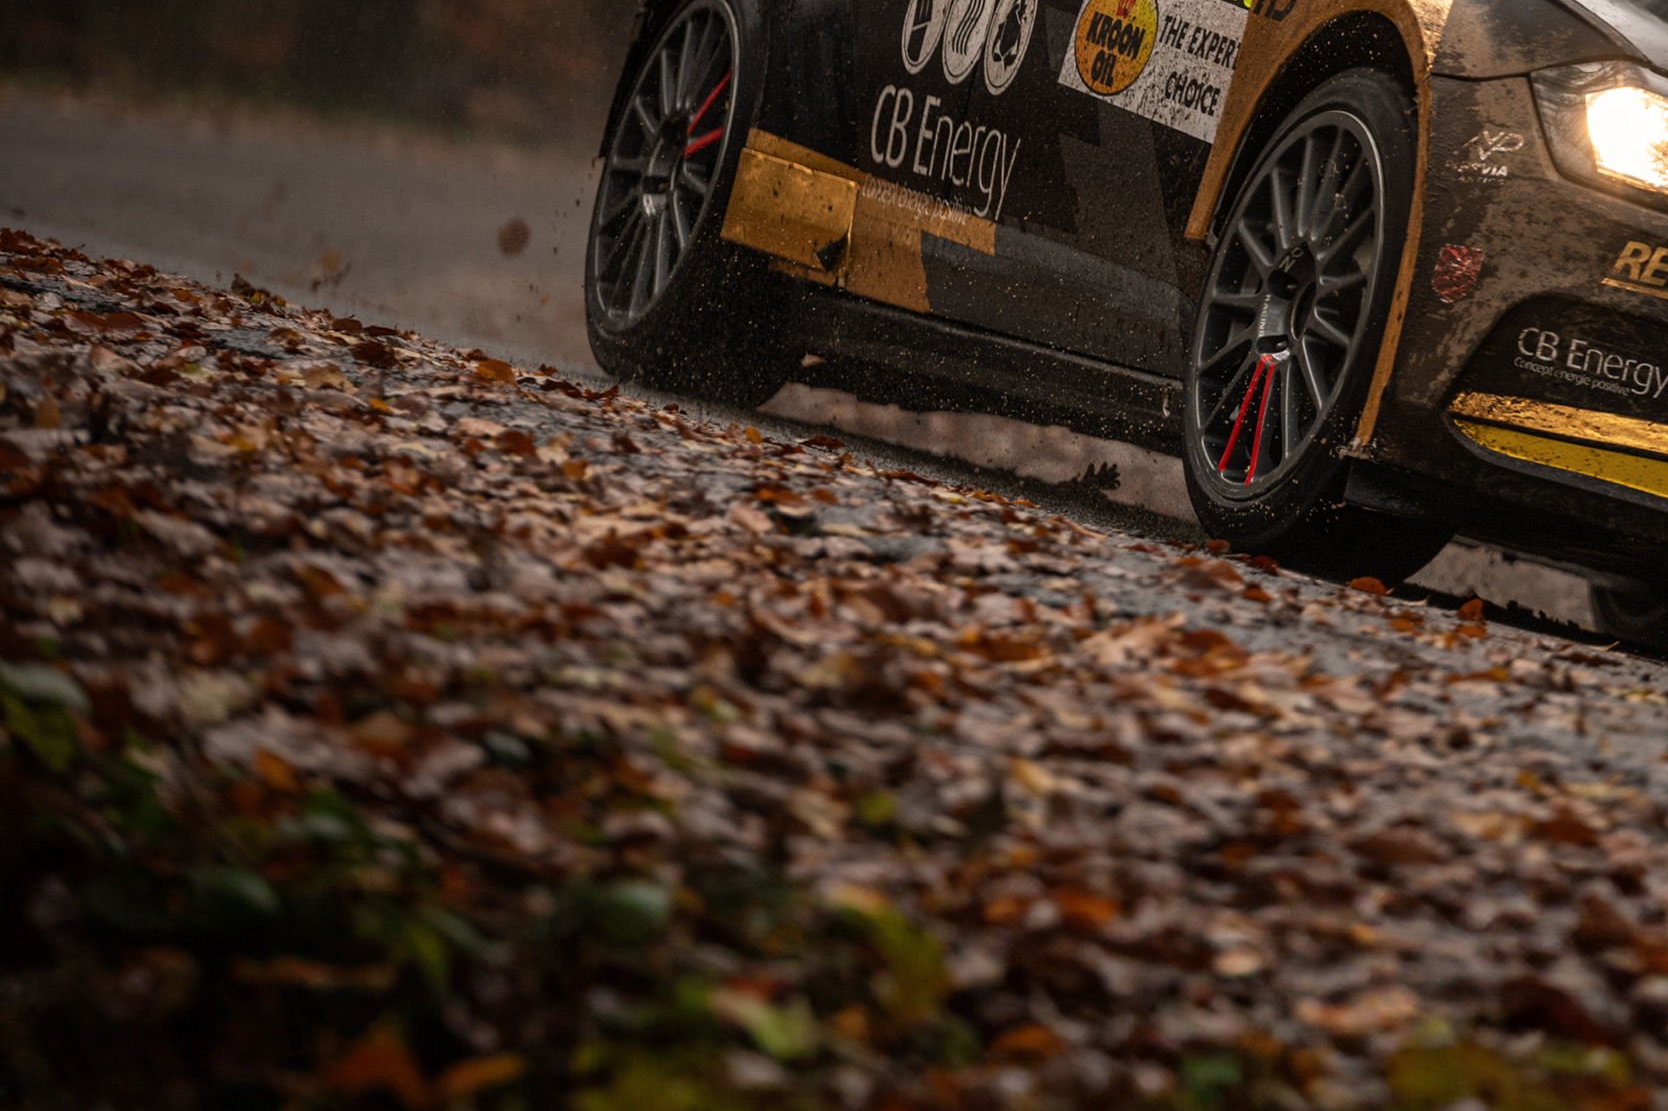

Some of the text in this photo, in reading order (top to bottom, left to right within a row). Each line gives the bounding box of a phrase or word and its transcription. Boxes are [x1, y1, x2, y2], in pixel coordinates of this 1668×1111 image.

[1085, 11, 1146, 61] KROON
[1158, 15, 1189, 50] THE
[1091, 49, 1117, 88] OIL
[1164, 71, 1221, 116] CHOICE
[870, 84, 1021, 221] CB Energy
[1517, 327, 1560, 362] CB
[1591, 378, 1630, 396] positive
